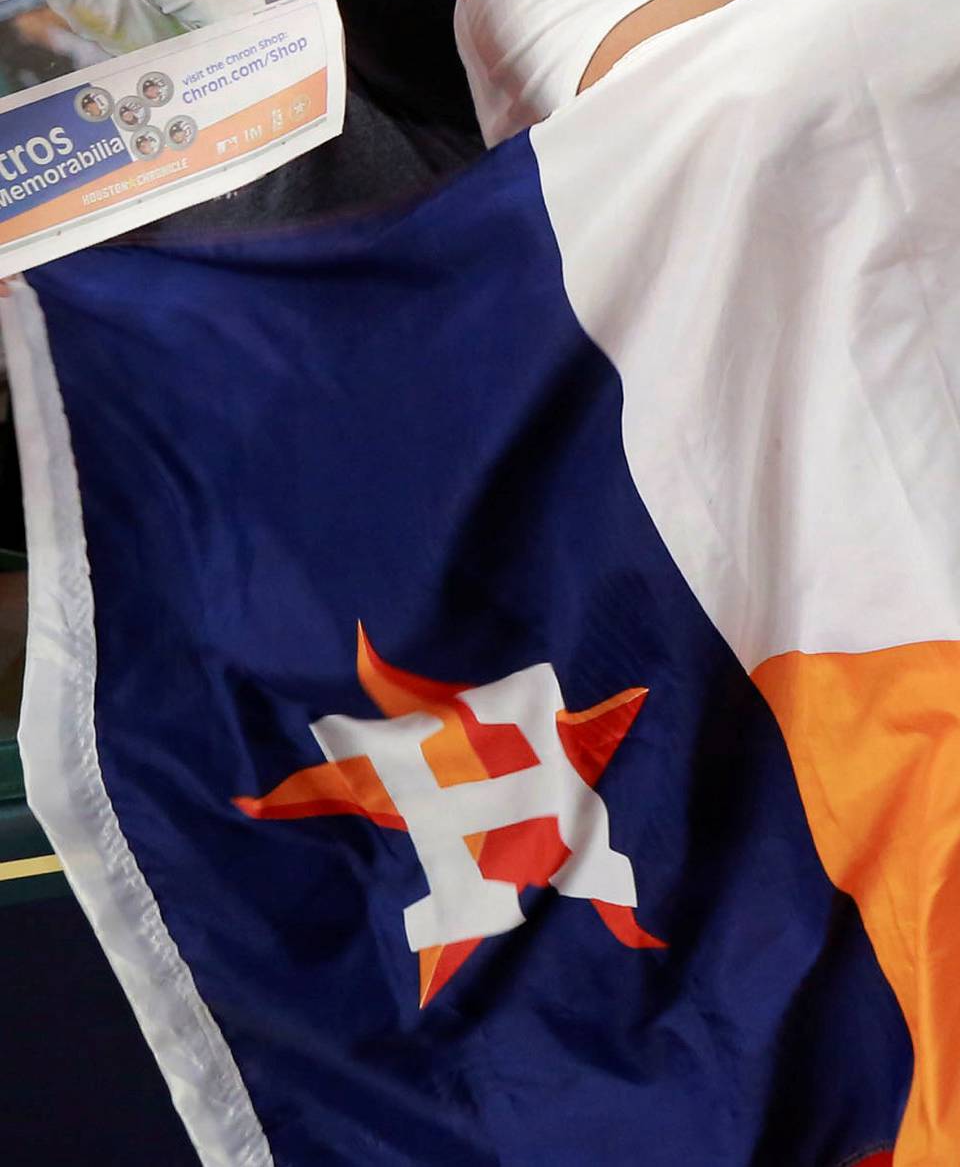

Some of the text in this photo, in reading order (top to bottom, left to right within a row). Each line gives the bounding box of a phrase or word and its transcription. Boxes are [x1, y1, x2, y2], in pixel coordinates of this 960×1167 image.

[182, 31, 288, 86] visit the Chron Shop:
[182, 36, 308, 104] Chron.com/Shop
